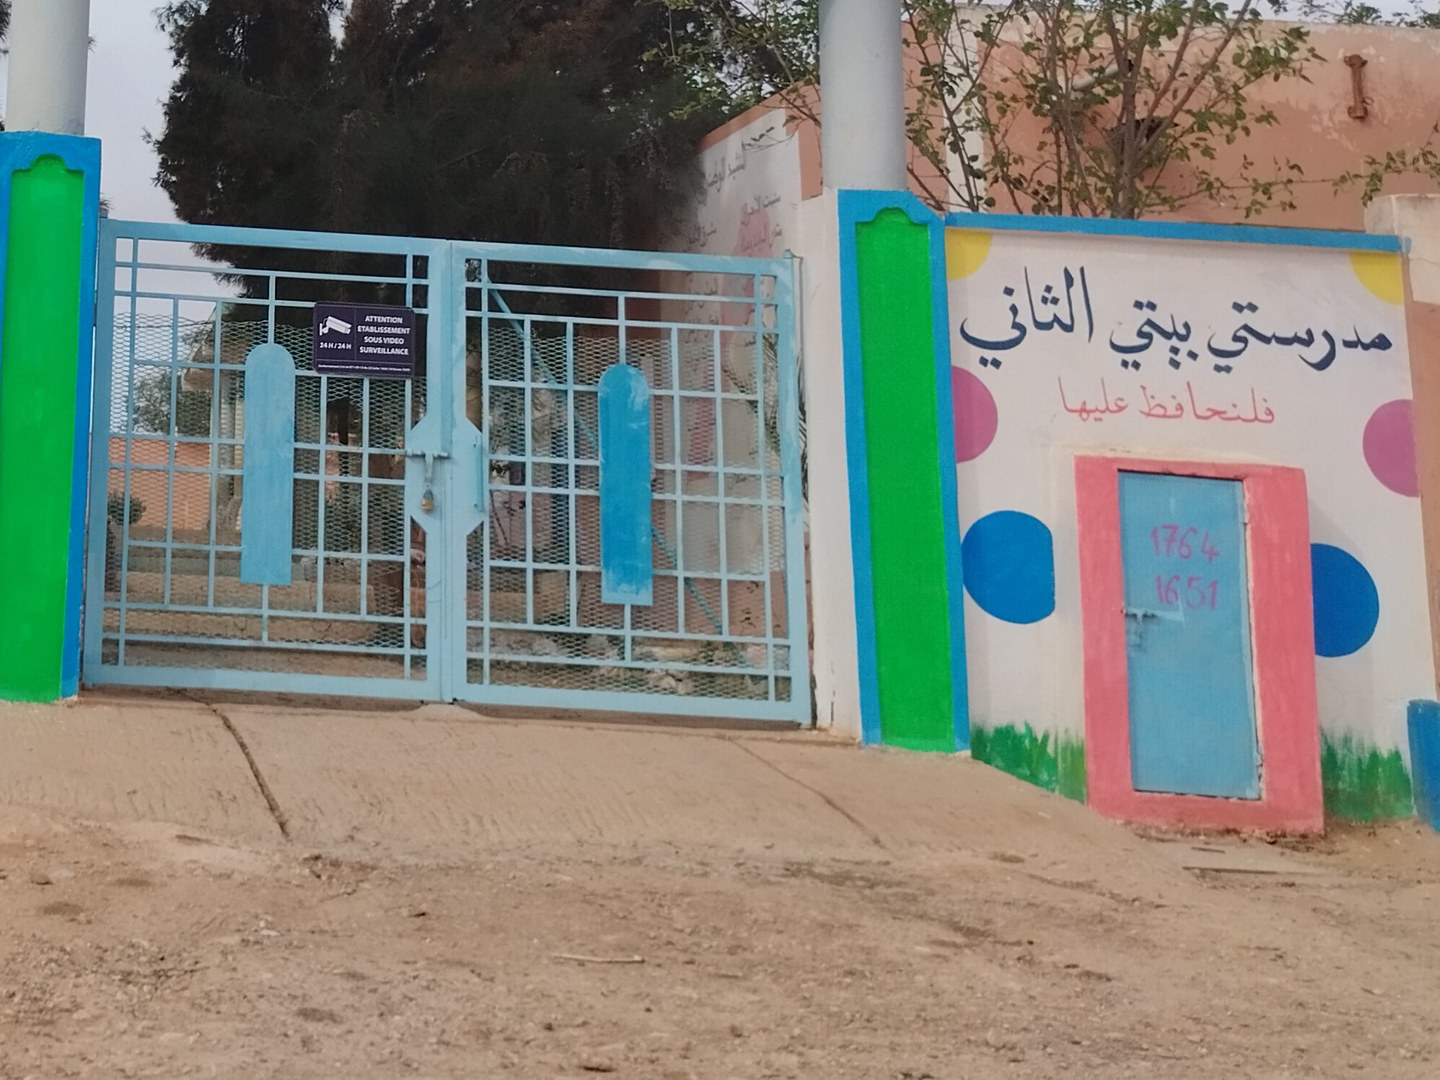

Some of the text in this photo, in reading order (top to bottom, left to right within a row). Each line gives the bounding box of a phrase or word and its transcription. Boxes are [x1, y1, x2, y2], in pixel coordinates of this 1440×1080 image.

[365, 315, 403, 324] ATTENTION
[959, 265, 1393, 374] مدرستي بيتي الثاني
[357, 325, 411, 335] ETABLISSEMENT
[364, 336, 405, 345] SOUS VIDEO
[359, 346, 409, 356] SURVEILLANCE
[1149, 522, 1221, 563] 1764
[1154, 573, 1219, 610] 1651
